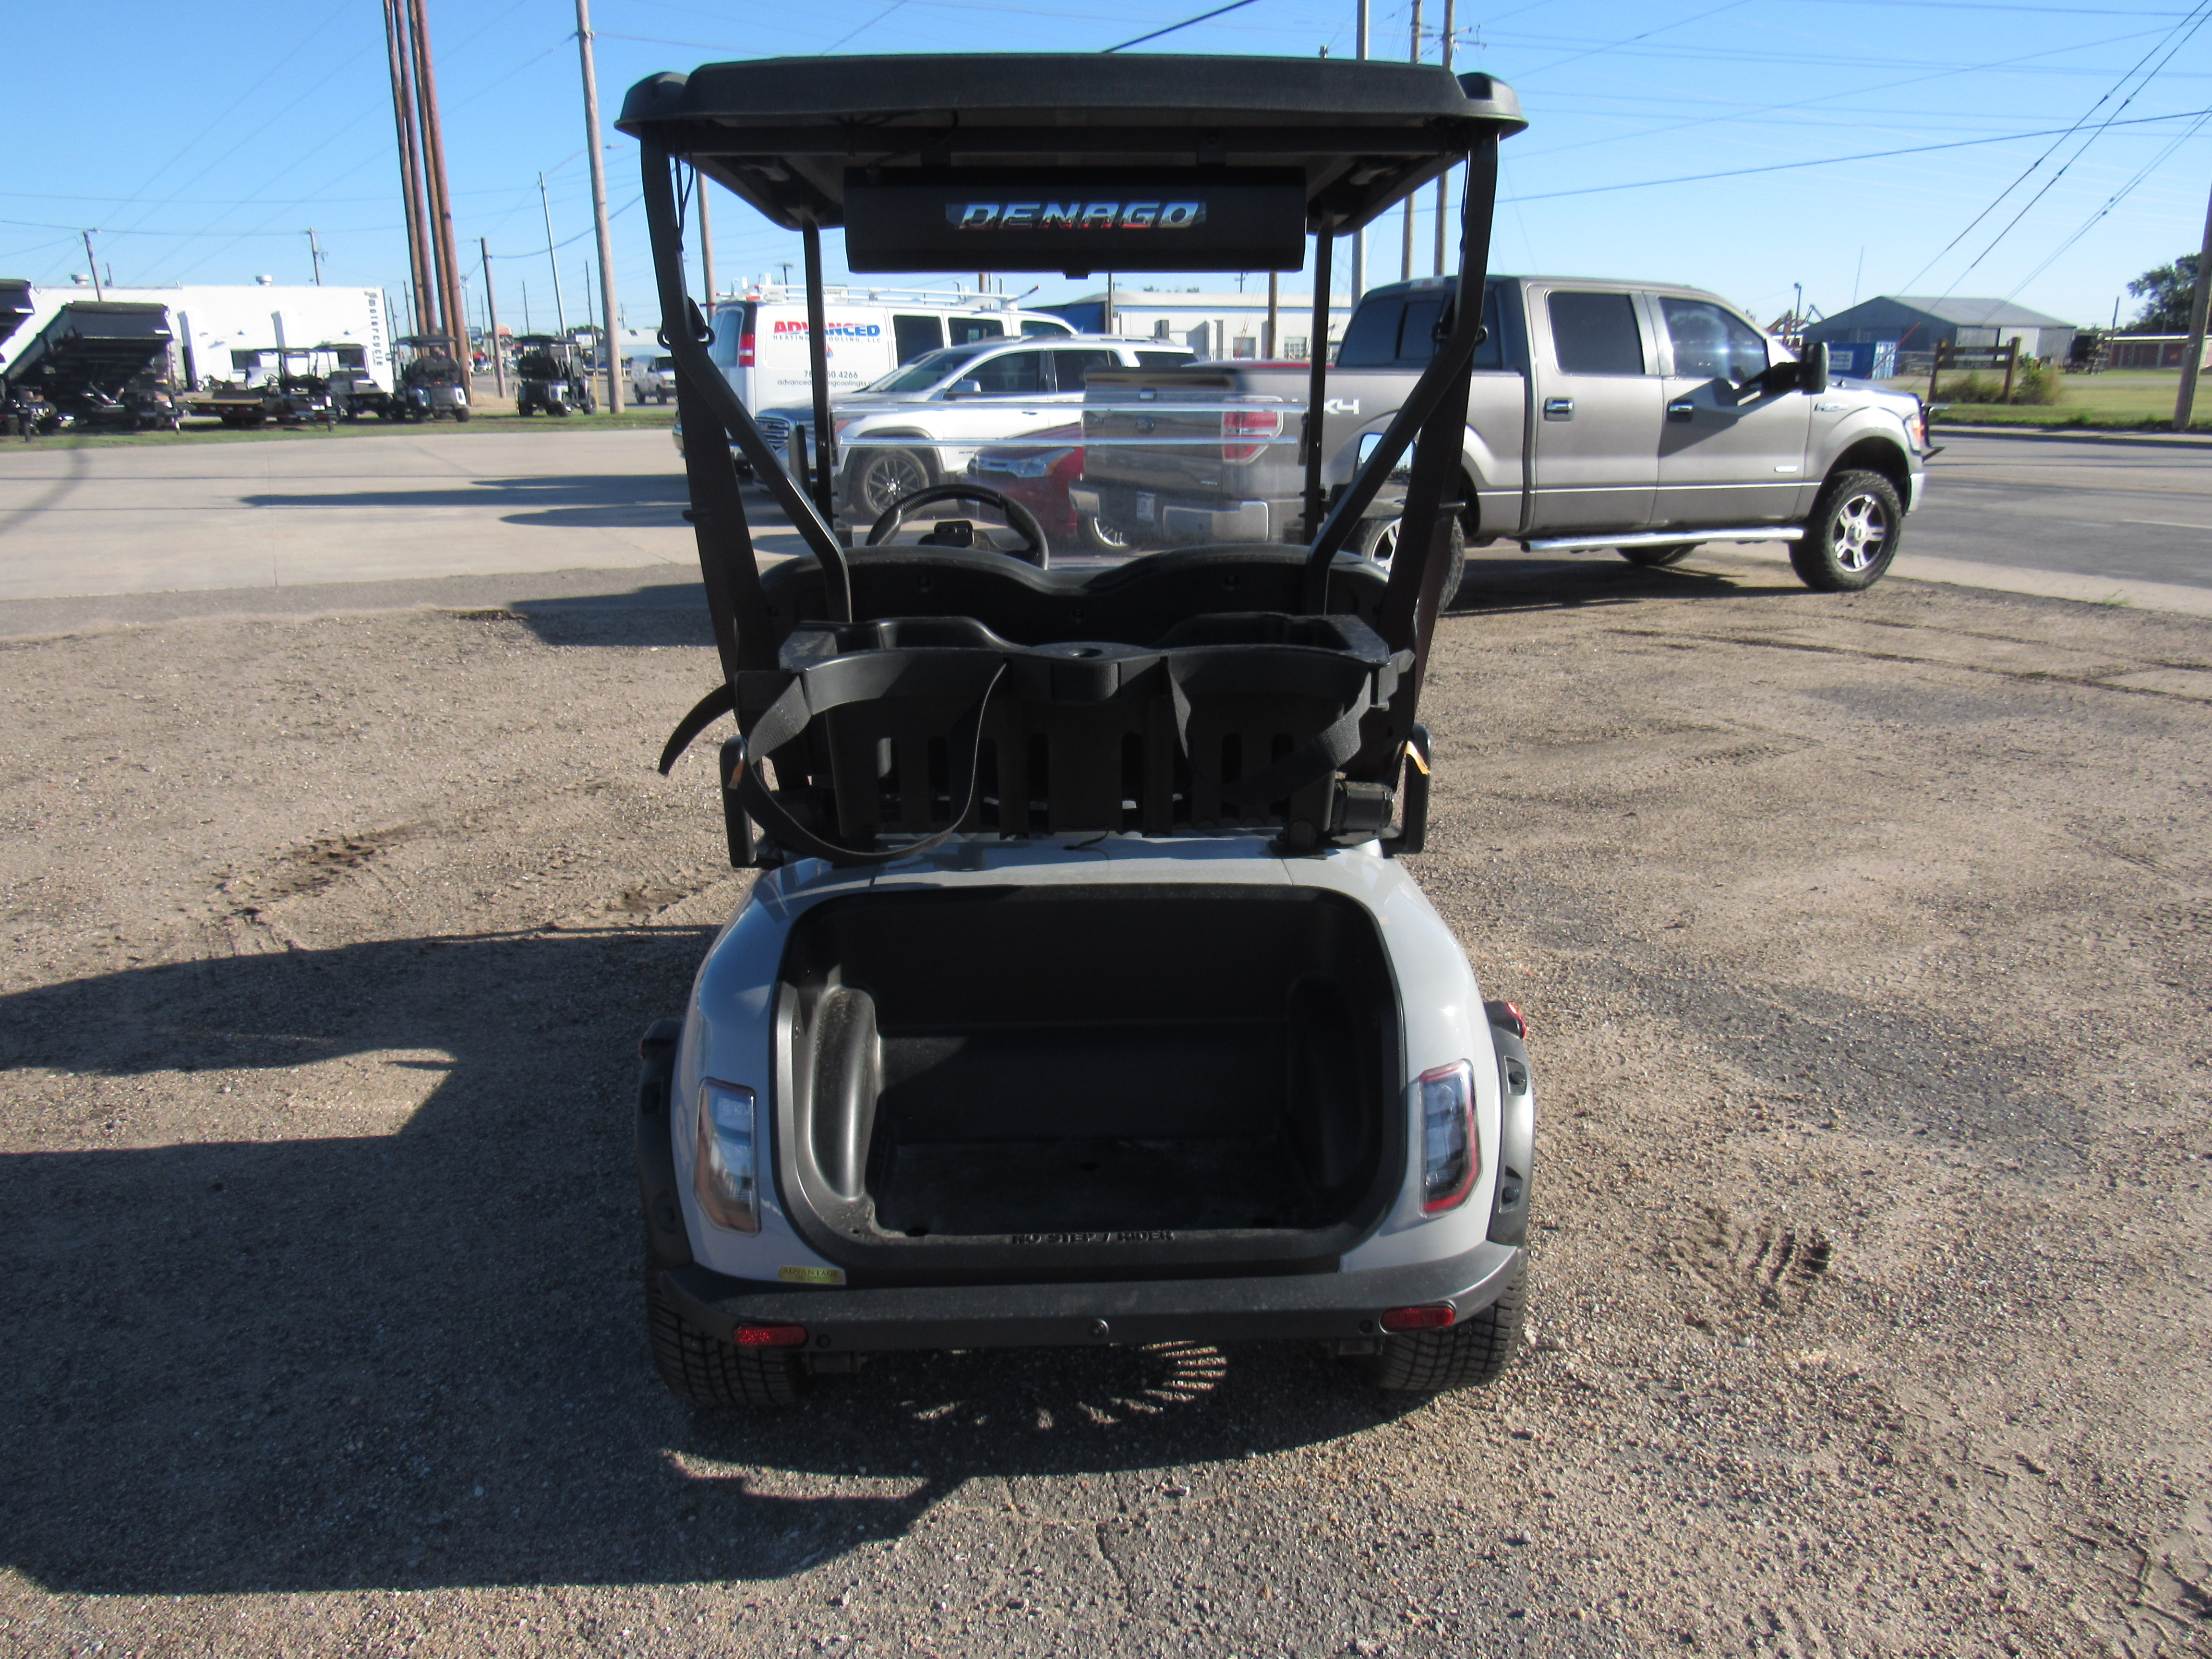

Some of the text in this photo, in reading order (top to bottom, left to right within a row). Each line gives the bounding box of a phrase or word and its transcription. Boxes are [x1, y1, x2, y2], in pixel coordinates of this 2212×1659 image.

[960, 202, 1200, 229] DENAGO
[1012, 1233, 1041, 1244] NO
[1048, 1232, 1096, 1243] STEP
[1117, 1230, 1175, 1241] RIDER
